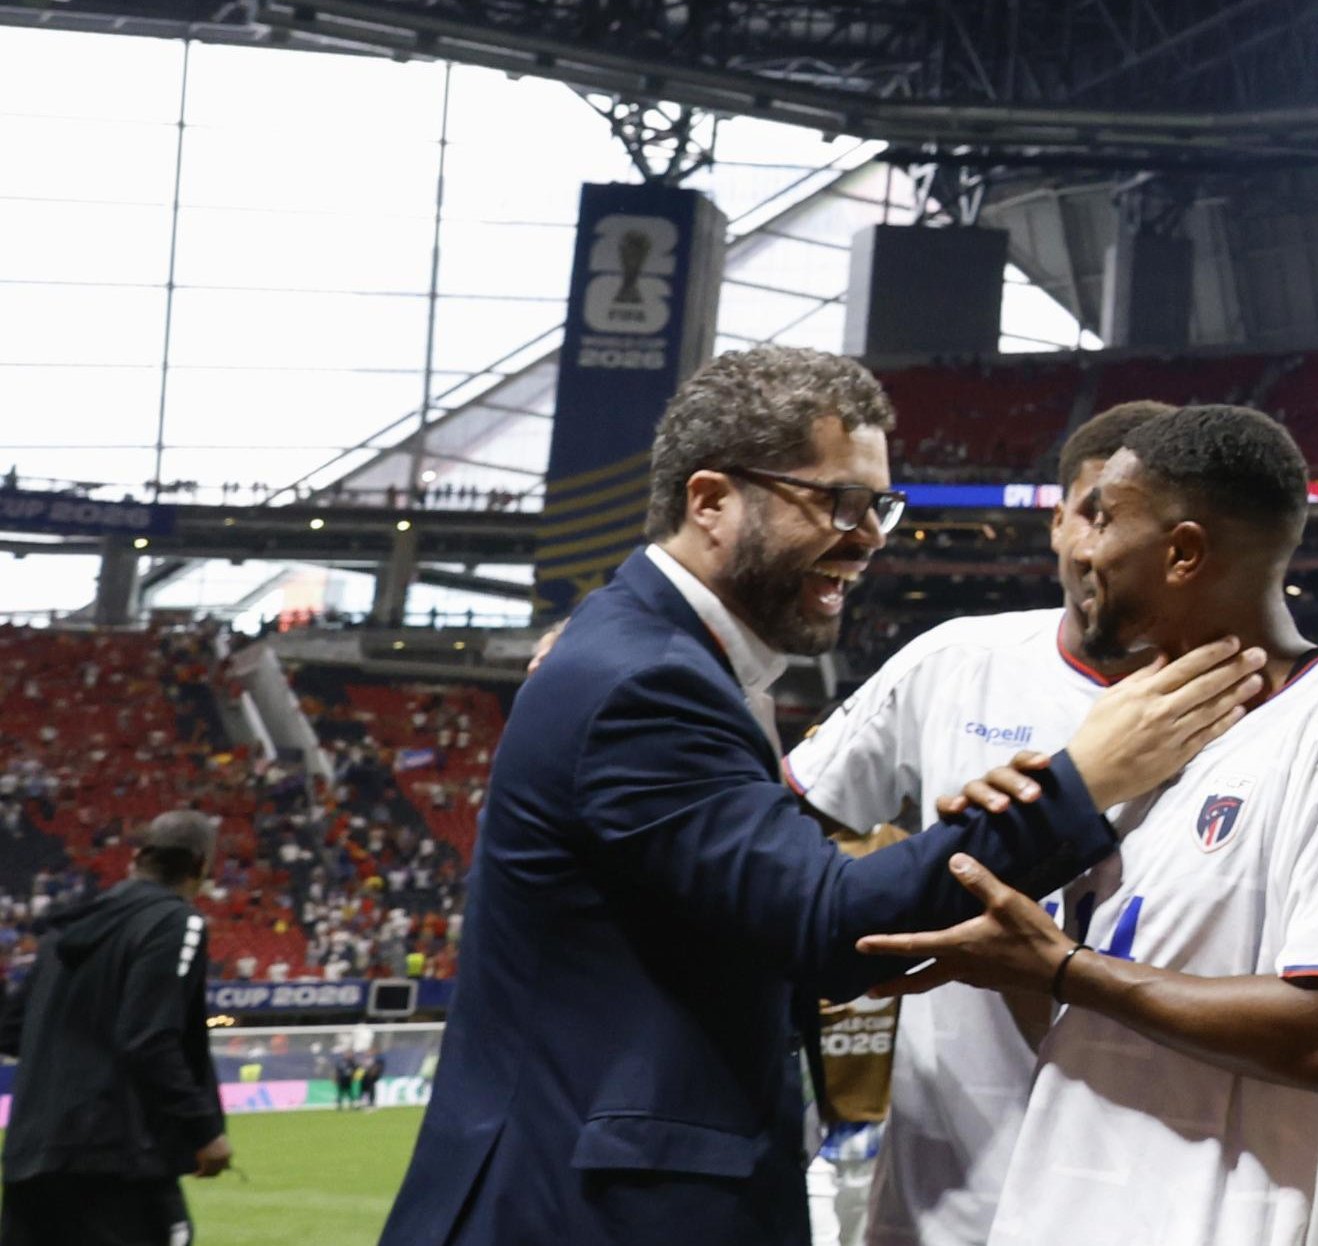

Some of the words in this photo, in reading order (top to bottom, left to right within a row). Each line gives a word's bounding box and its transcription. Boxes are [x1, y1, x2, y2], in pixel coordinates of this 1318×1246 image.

[964, 720, 1034, 743] capelli
[215, 987, 269, 1008] CUP
[271, 985, 361, 1007] 2026
